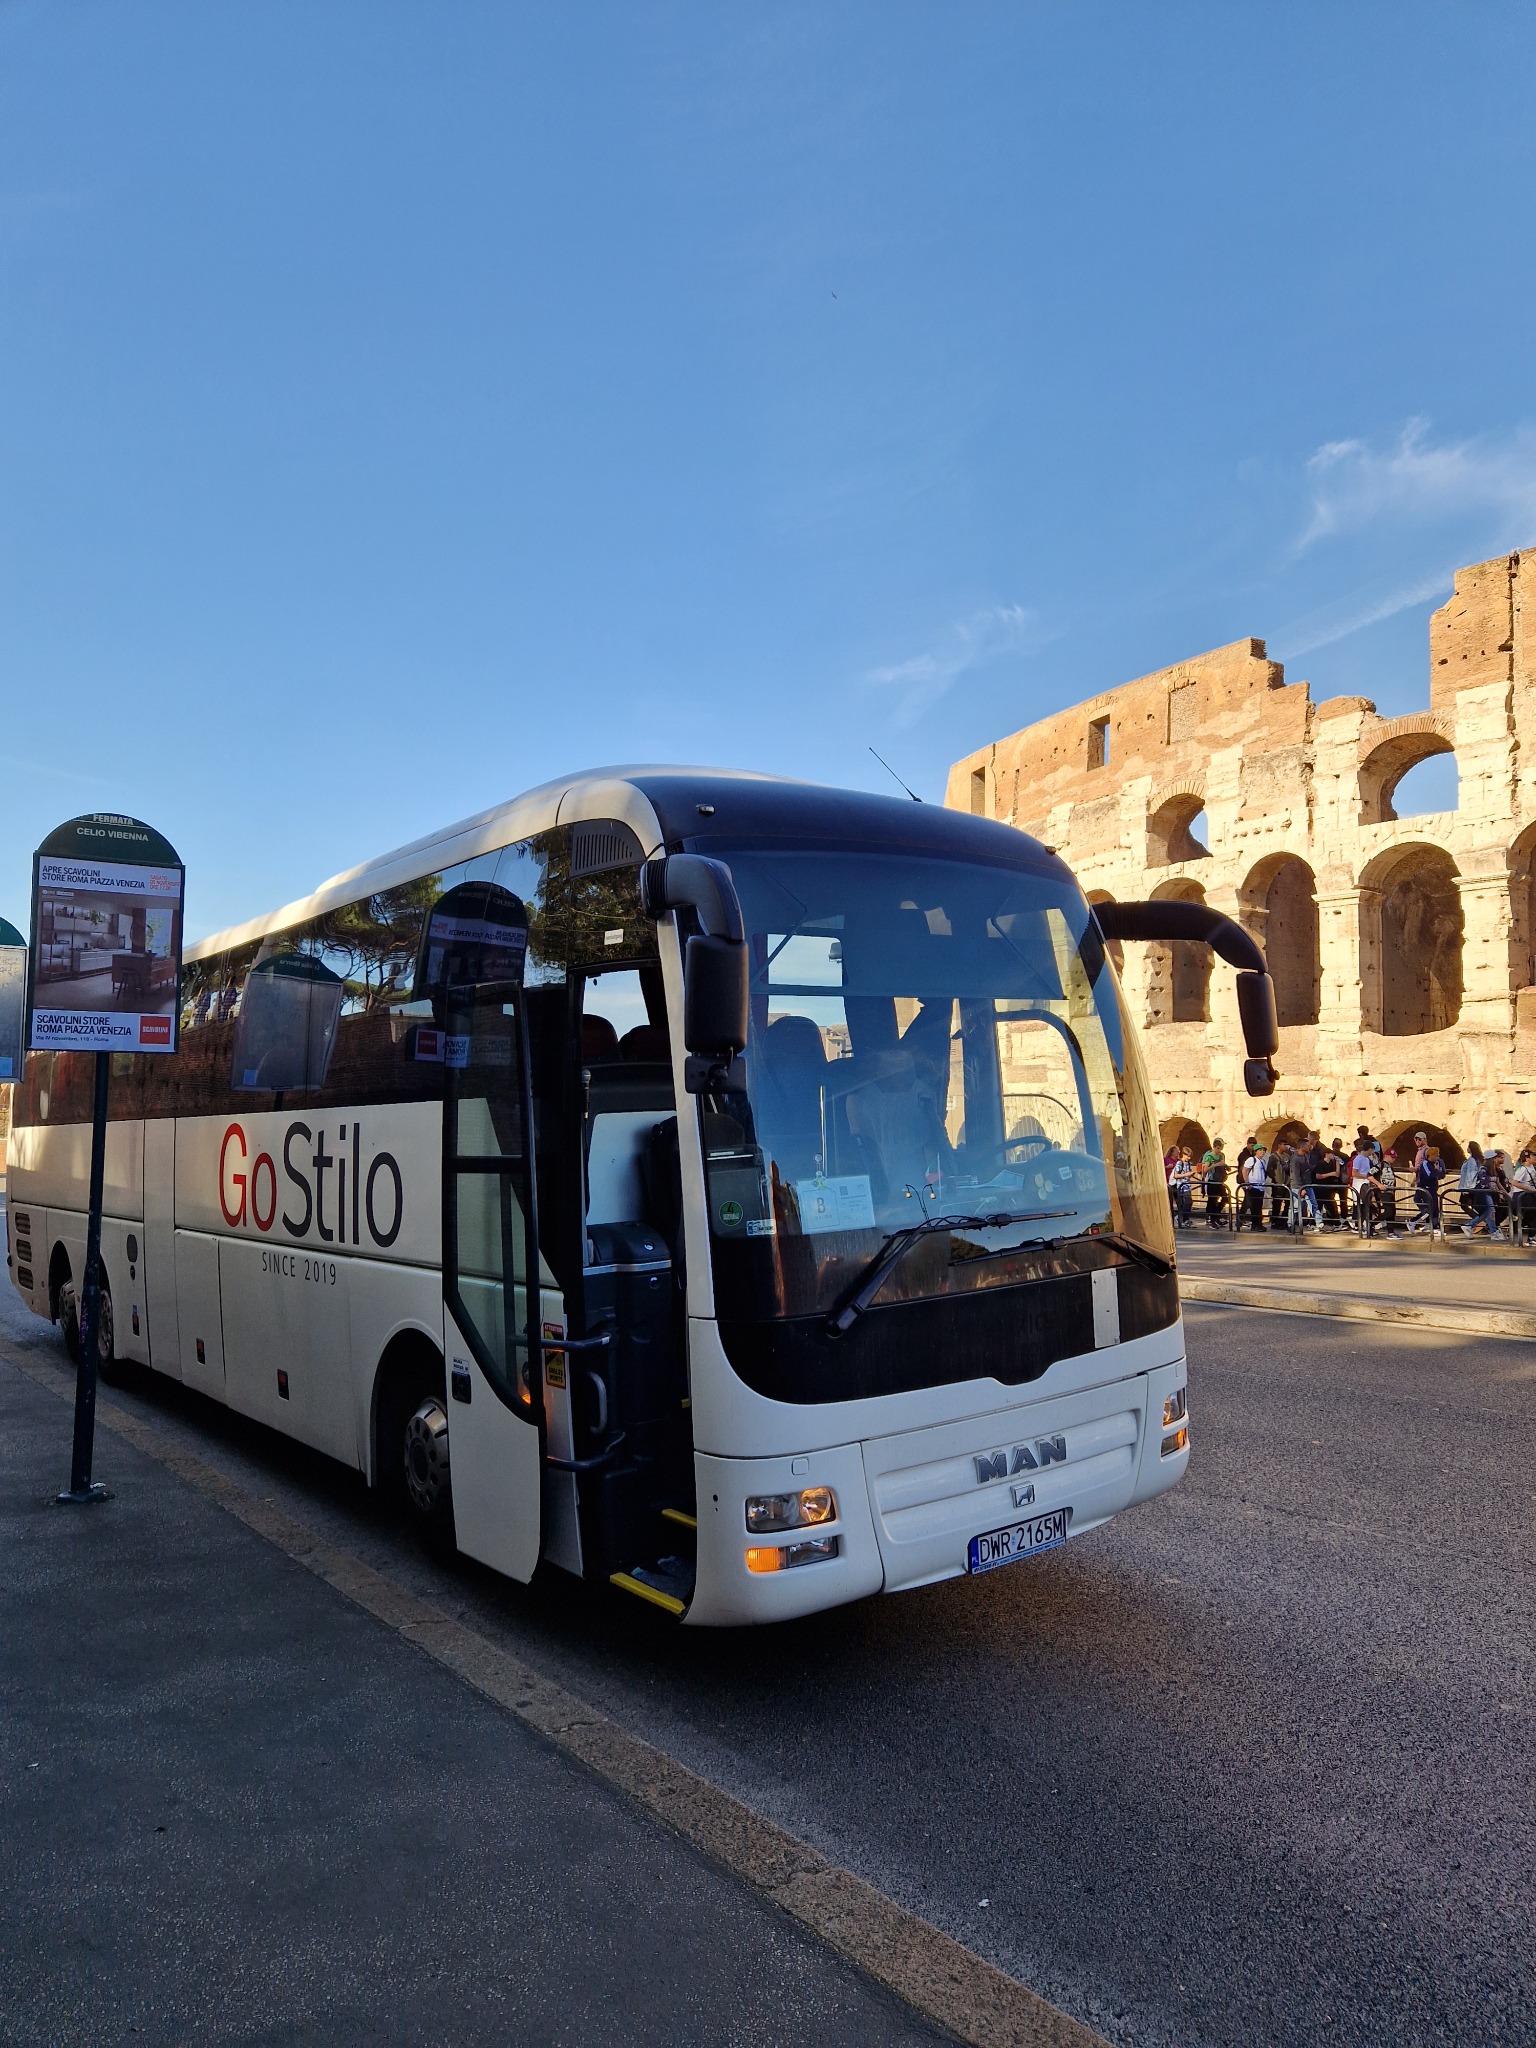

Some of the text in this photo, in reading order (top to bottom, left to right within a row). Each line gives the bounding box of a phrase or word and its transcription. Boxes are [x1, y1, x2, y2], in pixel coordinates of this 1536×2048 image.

[93, 814, 134, 826] FERMATA
[76, 827, 149, 842] CELIO VIBENNA
[42, 865, 101, 877] APRE SCAVOLINI
[42, 872, 146, 889] STORE ROMA PIAZZA VENEZIA
[36, 1014, 111, 1026] SCAVOLINI STORE
[36, 1024, 132, 1036] ROMA PIAZZA VENEZIA
[219, 1121, 403, 1248] GoStilo
[727, 1202, 735, 1214] 4
[816, 1197, 827, 1214] B
[262, 1252, 337, 1286] SINCE 2019
[973, 1434, 1067, 1484] MAN
[980, 1531, 1012, 1563] DWR
[1016, 1513, 1063, 1551] 2165M
[971, 1556, 978, 1565] PL
